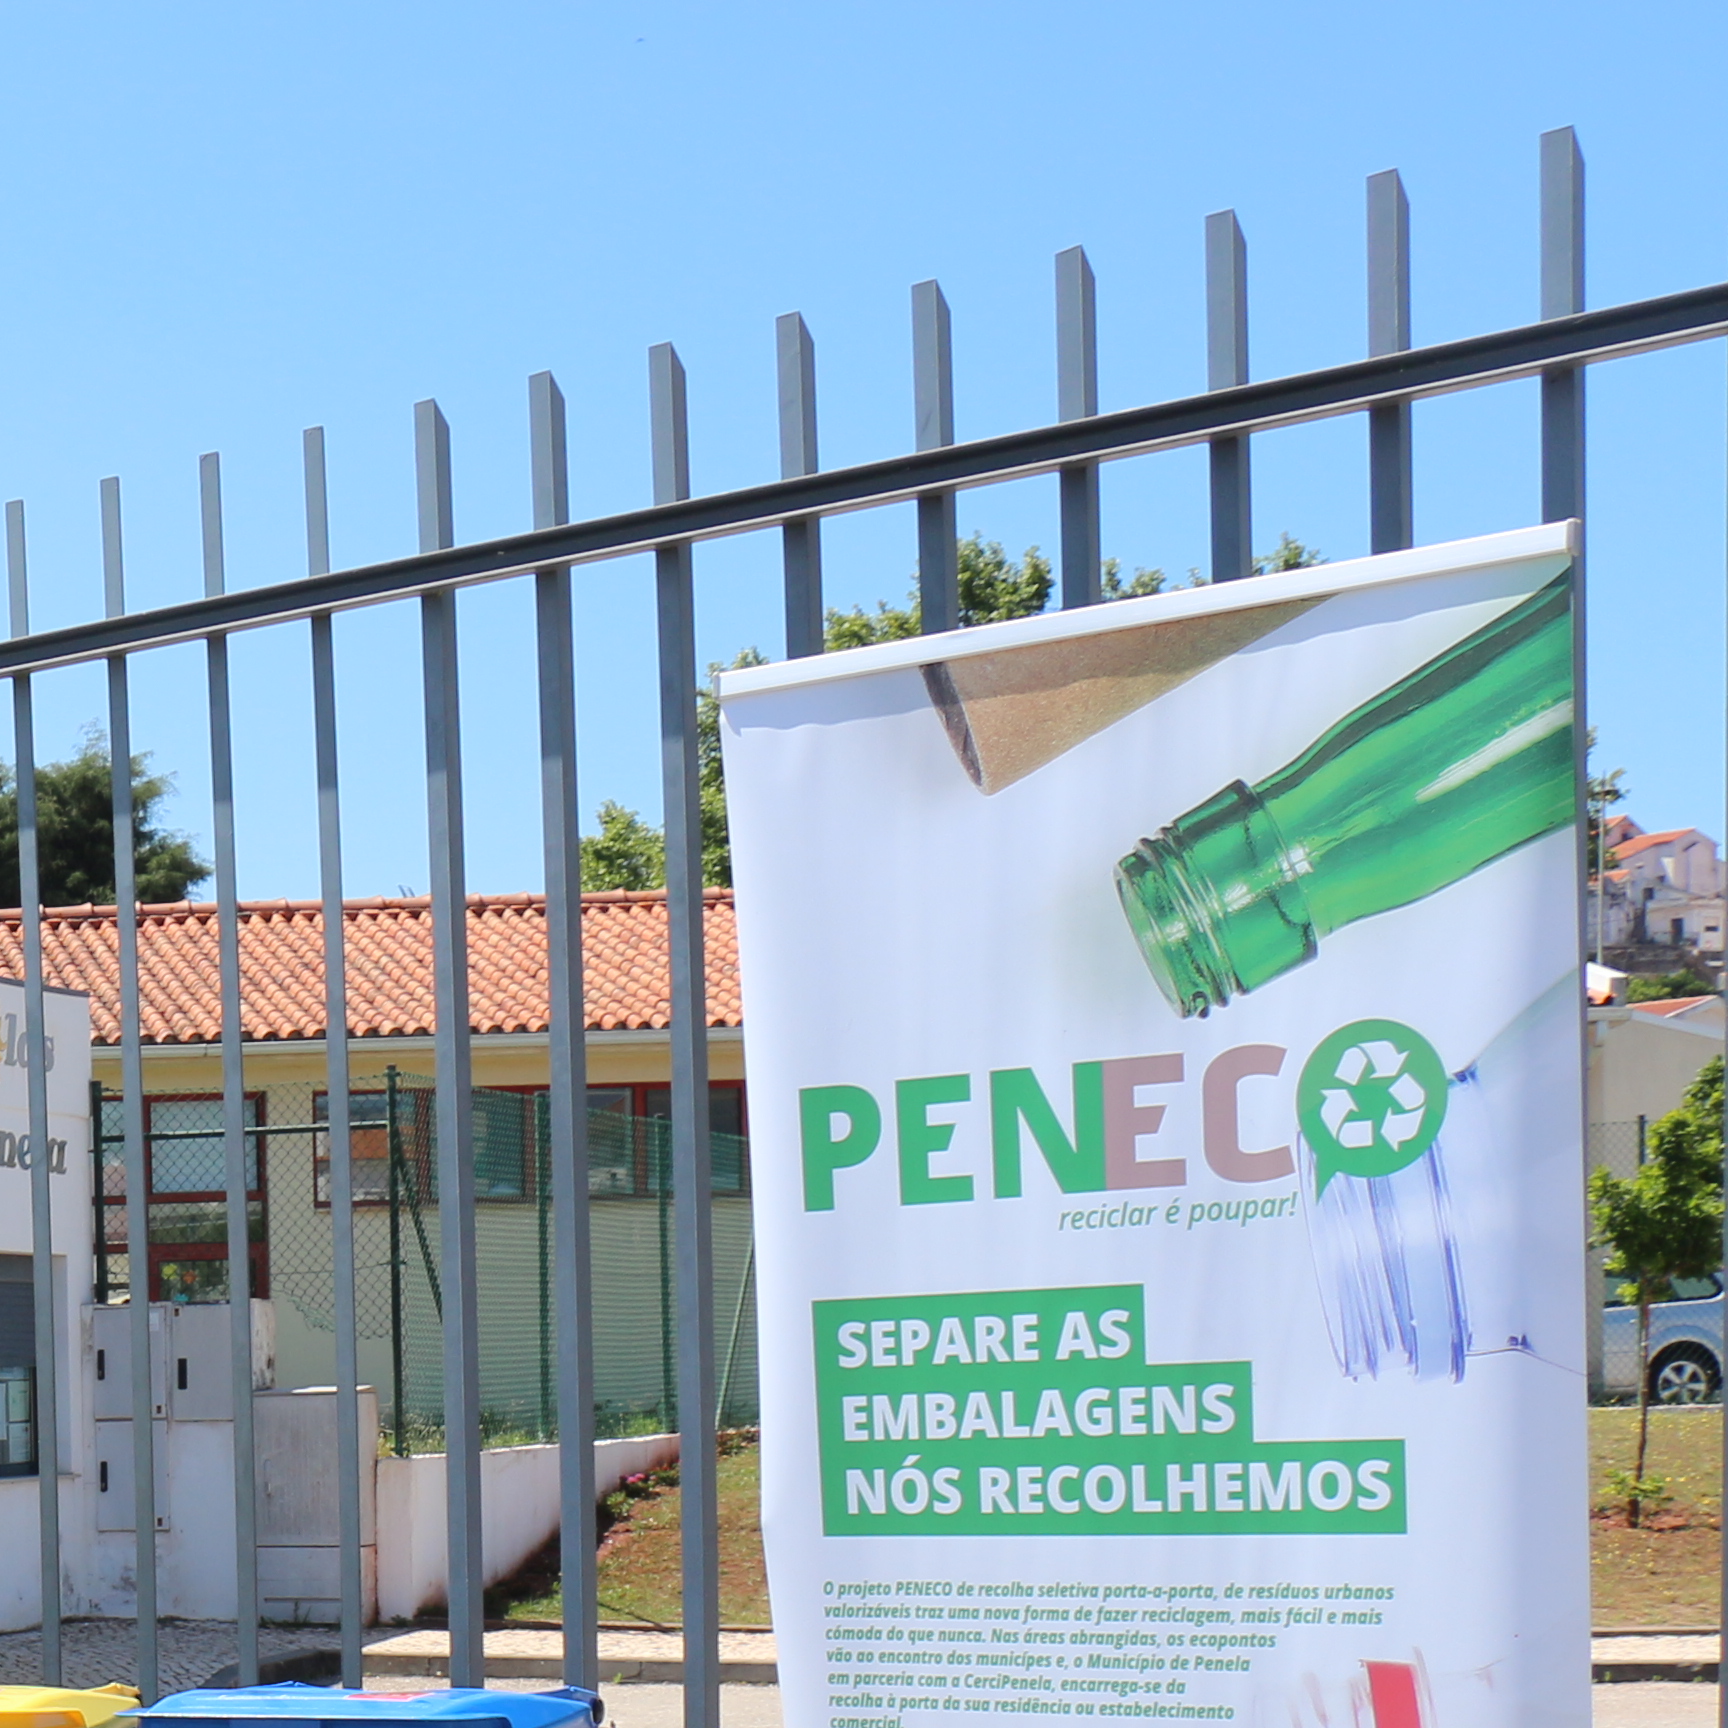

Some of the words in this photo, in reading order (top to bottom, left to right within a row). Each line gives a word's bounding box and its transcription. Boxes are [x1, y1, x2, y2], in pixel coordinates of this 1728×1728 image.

[1058, 1199, 1157, 1232] reciclar
[1165, 1197, 1181, 1226] é
[1187, 1192, 1298, 1231] poupar!
[837, 1313, 1039, 1369] SEPARE
[1056, 1309, 1131, 1360] AS
[842, 1383, 1236, 1443] EMBALAGENS
[845, 1455, 962, 1515] NÓS
[979, 1459, 1392, 1515] RECOLHEMOS
[823, 1581, 834, 1596] O
[836, 1580, 891, 1600] projeto
[895, 1581, 952, 1596] PENECO
[956, 1581, 974, 1597] de
[977, 1581, 1034, 1598] recolha
[1037, 1581, 1099, 1598] seletiva
[1102, 1584, 1217, 1603] porta-a-porta,
[1223, 1582, 1244, 1599] de
[1248, 1582, 1319, 1600] resíduos
[1324, 1583, 1394, 1600] urbanos
[824, 1602, 911, 1619] valorizáveis
[915, 1605, 944, 1619] traz
[947, 1607, 980, 1620] uma
[983, 1608, 1020, 1620] nova
[1021, 1605, 1070, 1625] forma
[1073, 1606, 1093, 1622] de
[1094, 1605, 1138, 1626] fazer
[1141, 1606, 1234, 1627] reciclagem,
[1240, 1606, 1281, 1624] mais
[1283, 1607, 1323, 1628] fácil
[1327, 1612, 1337, 1624] e
[1340, 1607, 1383, 1625] mais
[825, 1624, 882, 1640] cómoda
[886, 1626, 904, 1641] do
[907, 1630, 934, 1645] que
[937, 1630, 986, 1643] nunca.
[990, 1628, 1019, 1644] Nas
[1023, 1628, 1065, 1645] áreas
[1069, 1629, 1160, 1650] abrangidas,
[1166, 1634, 1185, 1647] os
[1189, 1633, 1276, 1652] ecopontos
[826, 1647, 853, 1662] vão
[856, 1651, 875, 1663] ao
[878, 1651, 943, 1665] encontro
[947, 1649, 973, 1666] dos
[975, 1650, 1052, 1671] municípes
[1056, 1656, 1068, 1670] e,
[1073, 1656, 1083, 1668] o
[1087, 1653, 1166, 1674] Município
[1170, 1654, 1190, 1671] de
[1193, 1655, 1251, 1672] Penela
[828, 1673, 850, 1685] em
[853, 1671, 914, 1689] parceria
[918, 1675, 948, 1688] com
[951, 1676, 961, 1688] a
[964, 1673, 1056, 1693] CerciPenela,
[1060, 1679, 1162, 1698] encarrega-se
[1166, 1678, 1186, 1694] da
[829, 1692, 883, 1708] recolha
[887, 1693, 896, 1708] à
[898, 1697, 939, 1713] porta
[942, 1695, 961, 1711] da
[964, 1699, 991, 1712] sua
[994, 1697, 1072, 1715] residência
[1075, 1703, 1095, 1715] ou
[1099, 1701, 1234, 1720] estabelecimento
